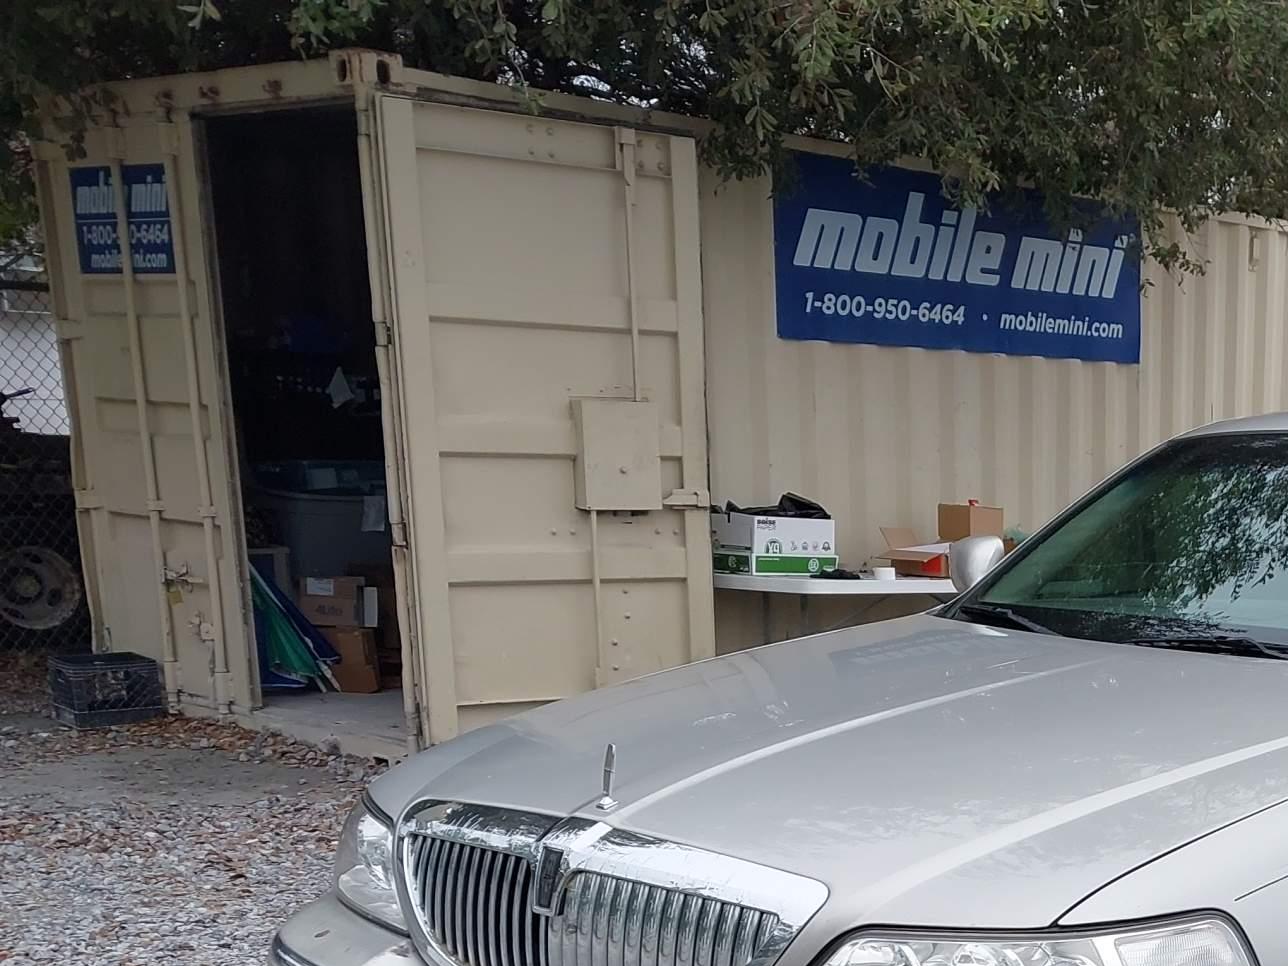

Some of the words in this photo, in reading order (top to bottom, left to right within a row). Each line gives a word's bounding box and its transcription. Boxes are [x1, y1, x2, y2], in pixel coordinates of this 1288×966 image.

[83, 223, 169, 245] 1-800-0-6464
[793, 192, 1006, 287] mobile
[1010, 228, 1128, 299] mini
[804, 291, 966, 325] 1-800-950-6464
[1000, 312, 1123, 339] mobilemini.com
